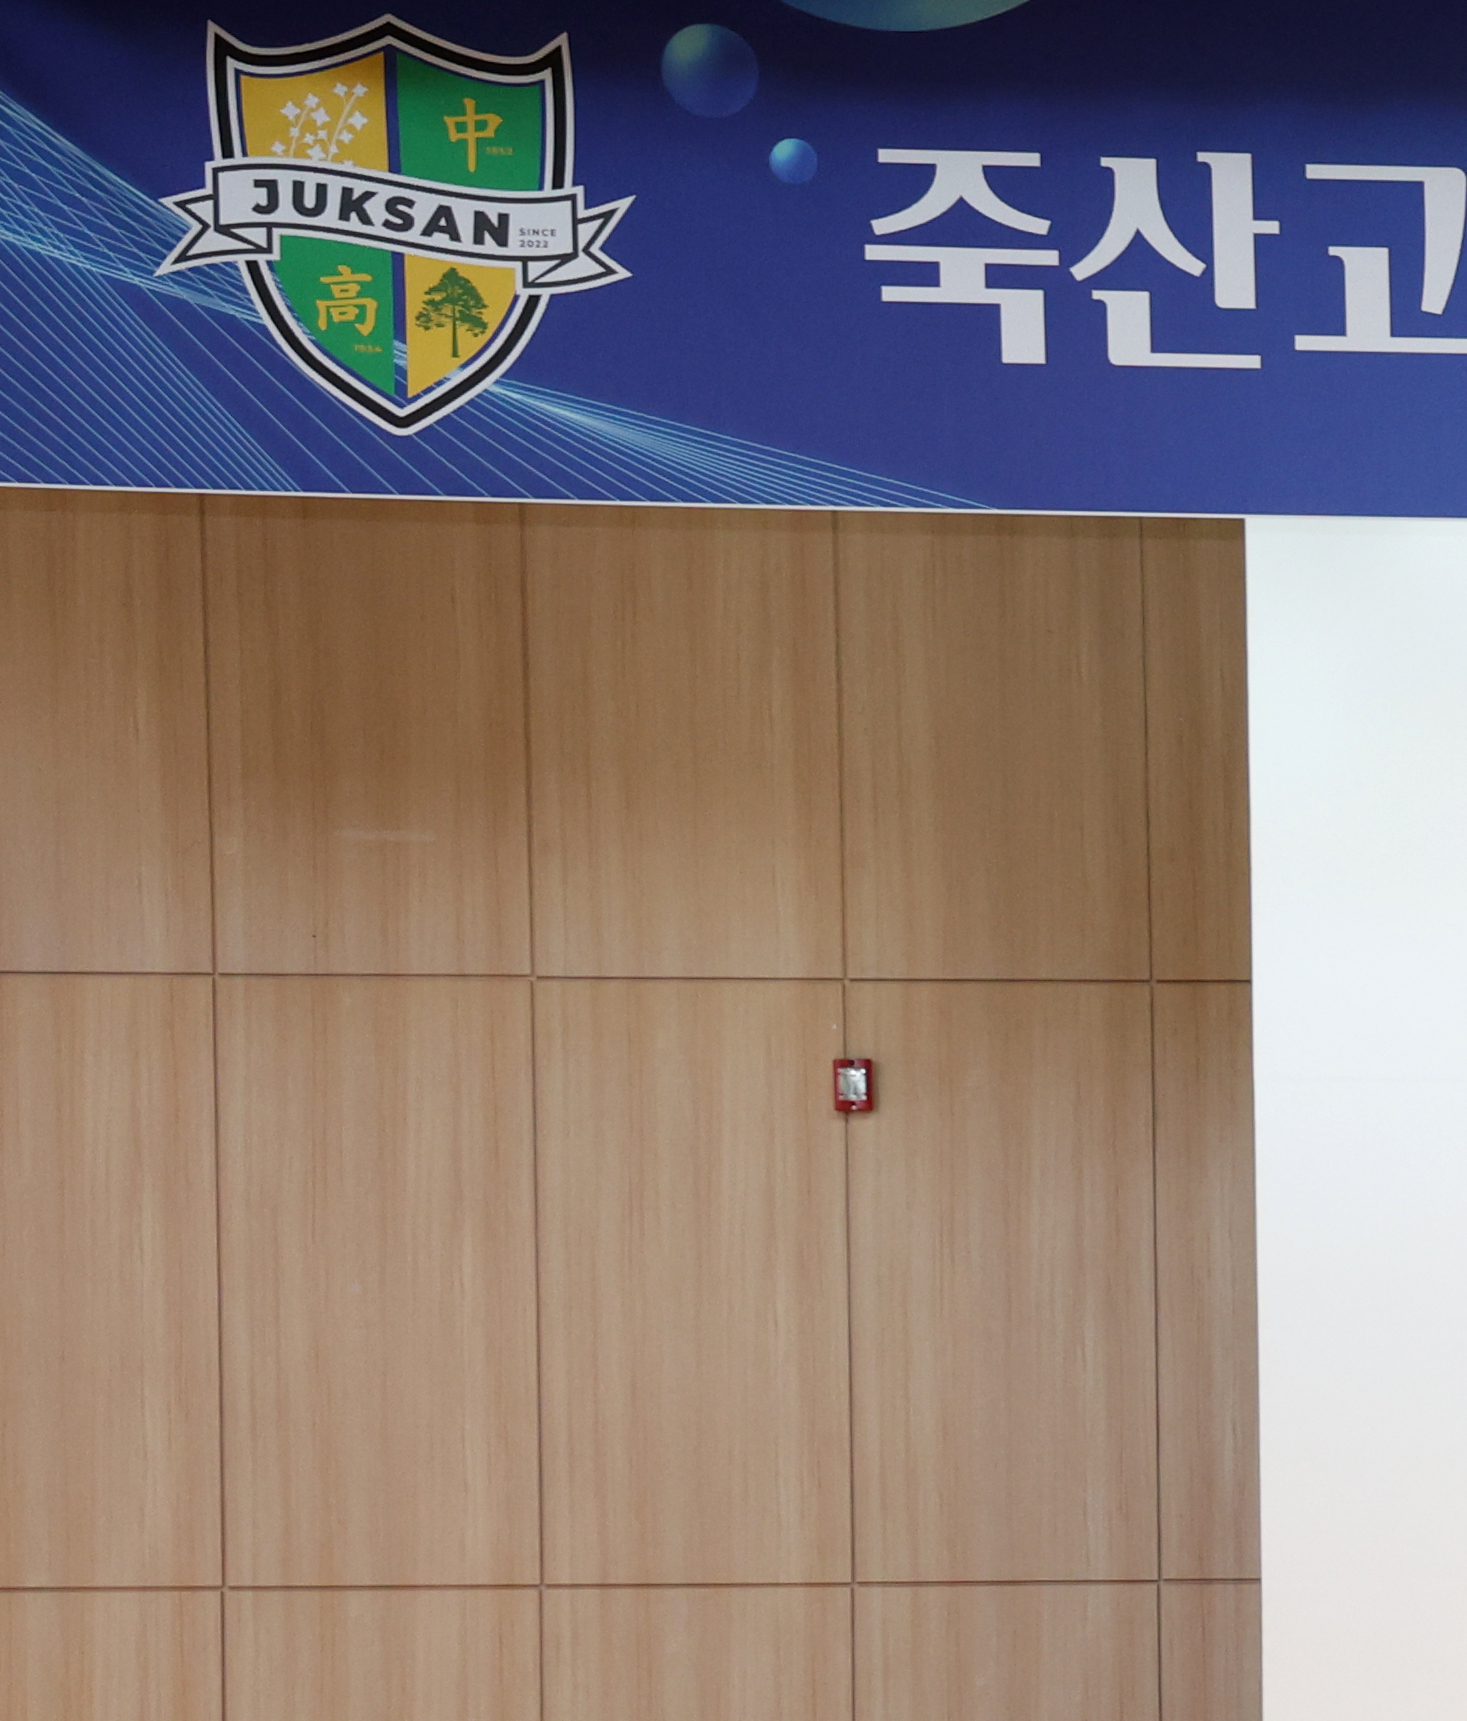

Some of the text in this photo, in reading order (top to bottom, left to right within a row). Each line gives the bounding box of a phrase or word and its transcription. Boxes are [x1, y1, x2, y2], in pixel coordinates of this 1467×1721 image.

[442, 97, 503, 173] 中
[251, 179, 510, 249] JUKSAN
[519, 228, 557, 237] SINCE
[315, 264, 379, 336] 高
